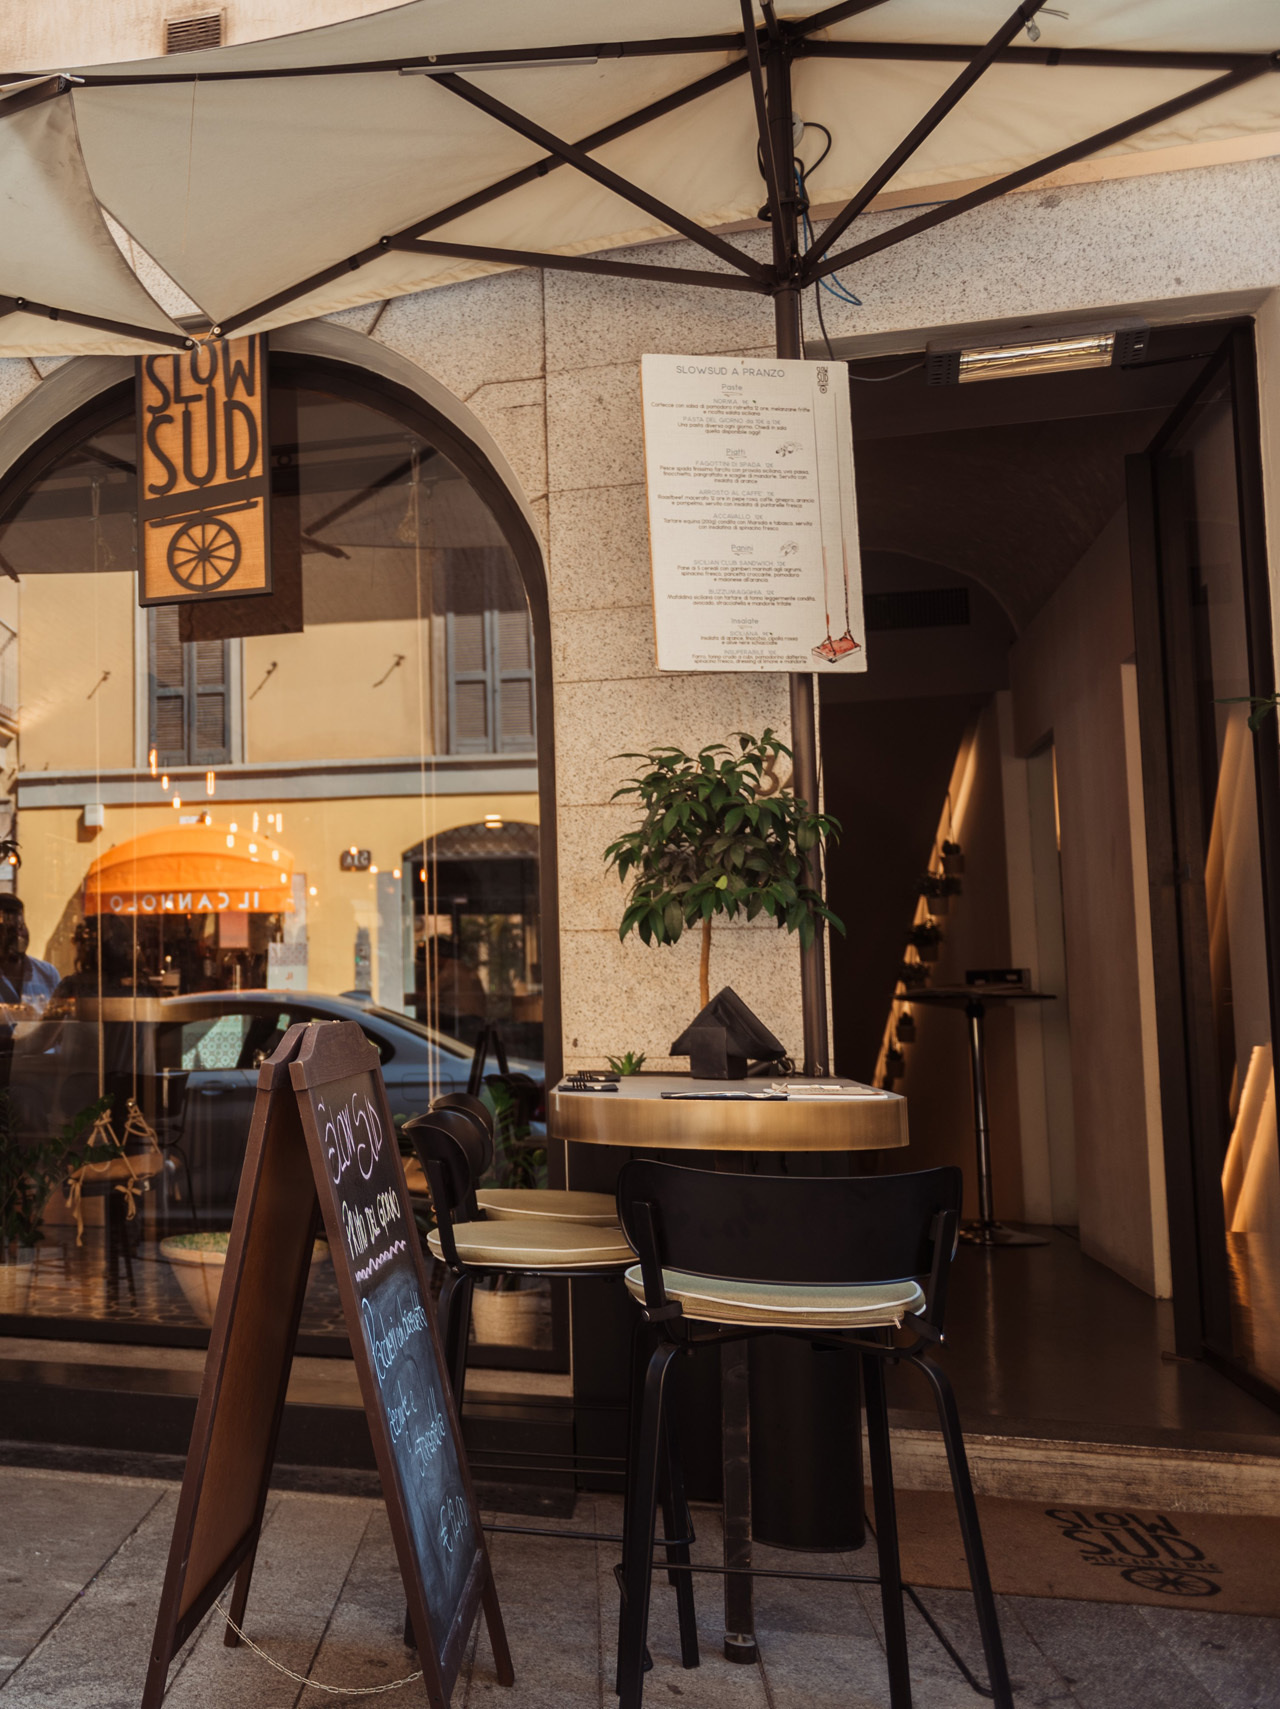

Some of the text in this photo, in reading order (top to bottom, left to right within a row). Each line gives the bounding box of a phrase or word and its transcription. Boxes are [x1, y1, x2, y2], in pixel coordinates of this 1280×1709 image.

[146, 334, 256, 414] SLOW
[676, 365, 785, 378] SLOWSUD A PRANZO
[146, 386, 258, 496] SUD
[726, 448, 746, 456] Piatti
[731, 544, 754, 552] Panini
[1045, 1509, 1182, 1536] SLOW
[1062, 1527, 1206, 1561] SUD
